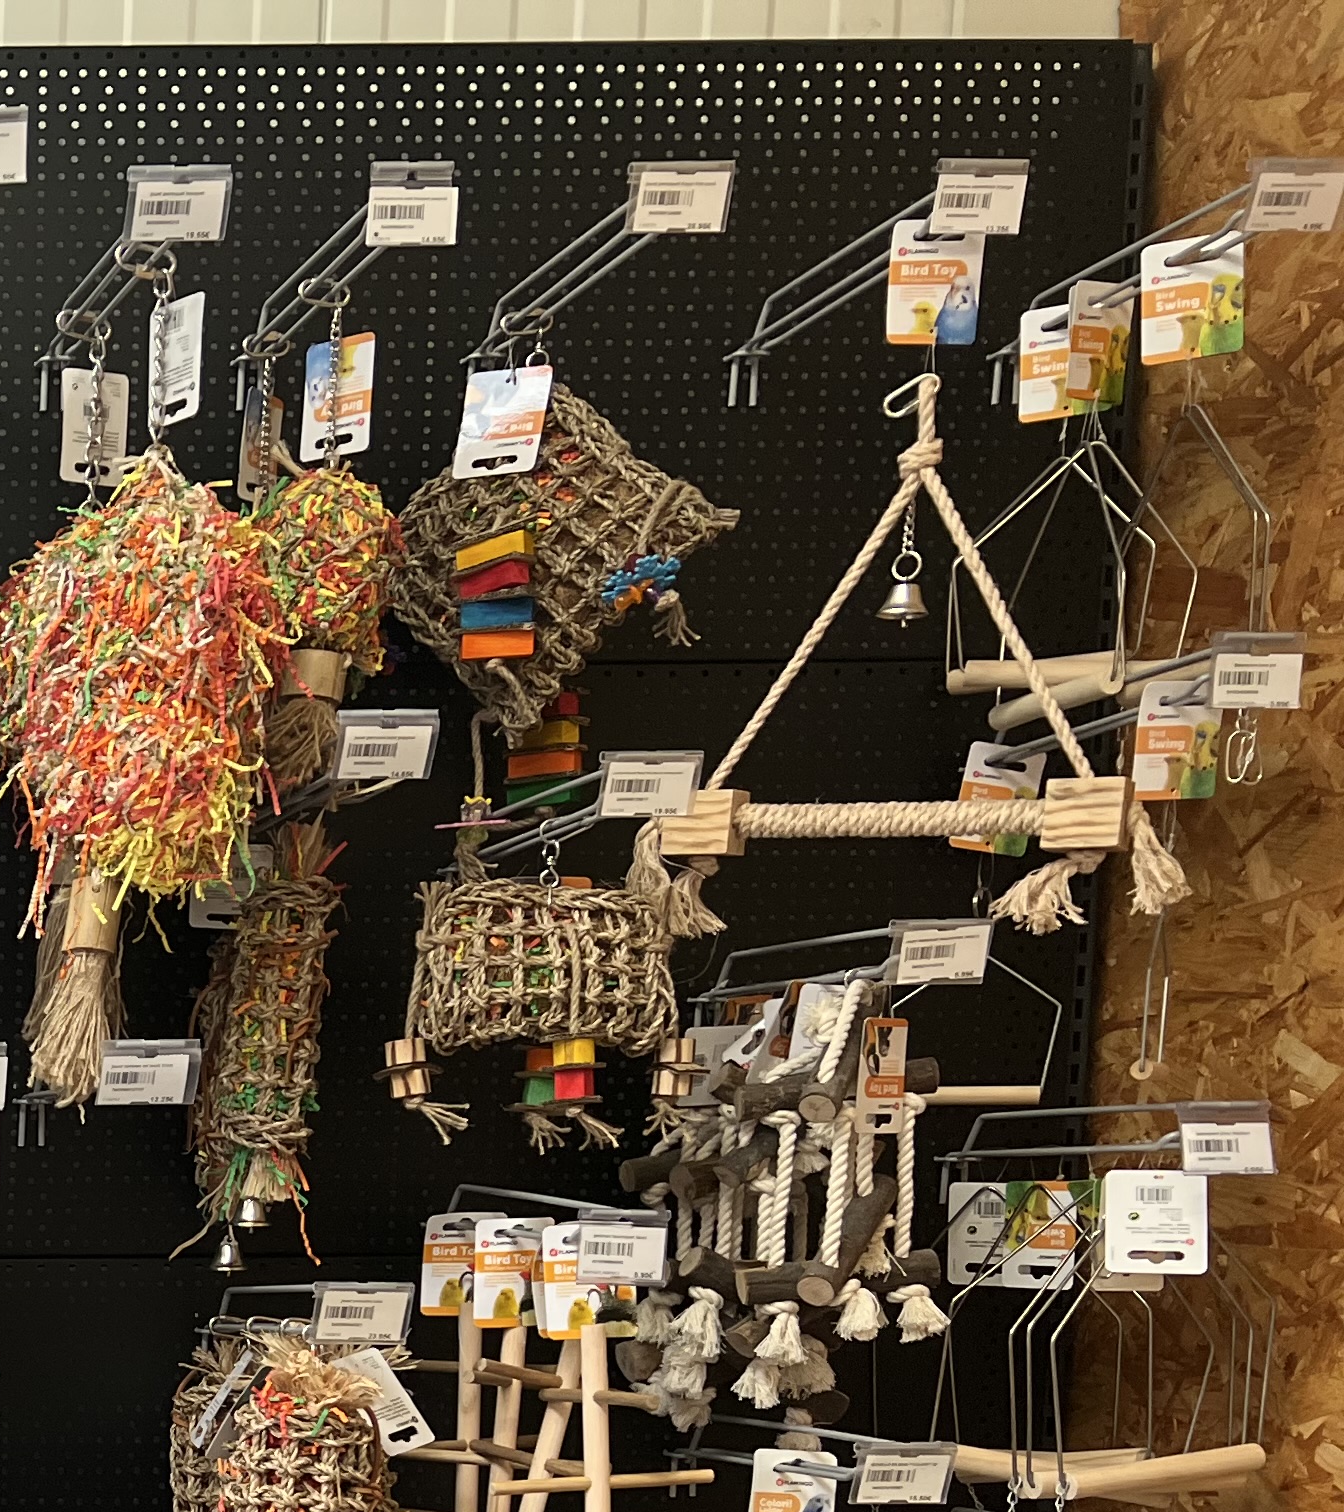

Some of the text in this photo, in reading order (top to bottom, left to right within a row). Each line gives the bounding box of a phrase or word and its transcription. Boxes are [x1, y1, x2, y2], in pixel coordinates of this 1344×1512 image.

[900, 264, 958, 277] Bird Toy
[1155, 290, 1175, 300] Bird
[1155, 296, 1200, 312] Swing
[1148, 737, 1185, 751] Swing
[432, 1246, 458, 1257] Bird
[484, 1254, 533, 1267] Bird Toy
